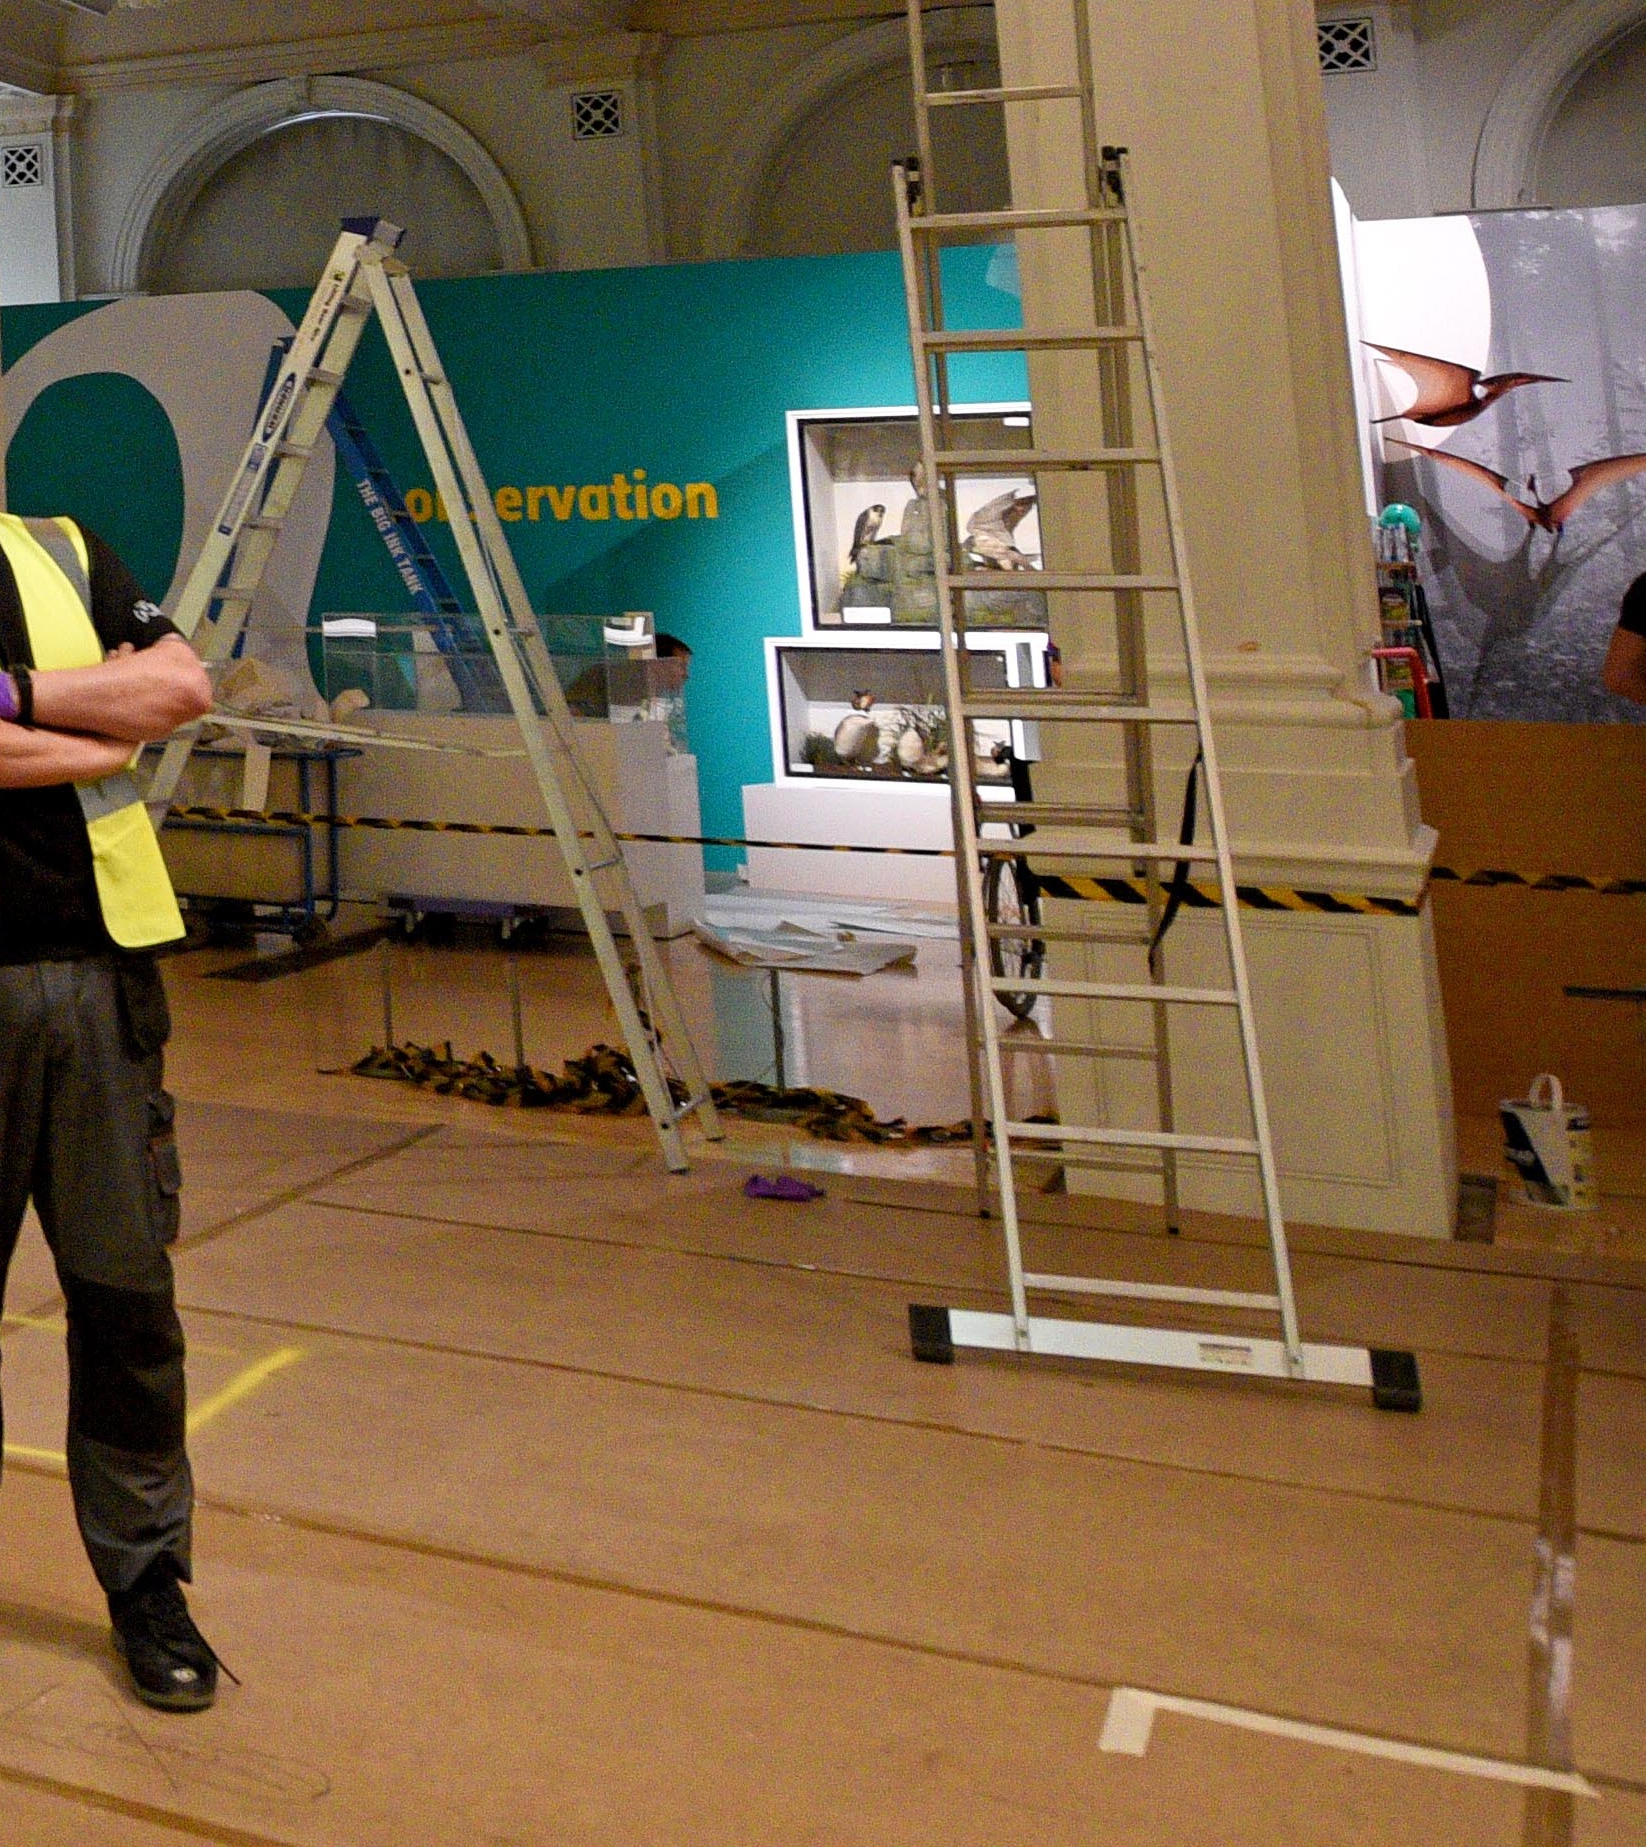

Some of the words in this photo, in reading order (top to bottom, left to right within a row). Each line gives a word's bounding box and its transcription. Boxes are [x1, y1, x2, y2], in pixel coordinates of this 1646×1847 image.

[356, 478, 379, 506] THE
[371, 506, 391, 531] BIG
[383, 532, 406, 558] INK
[397, 557, 424, 595] TANK
